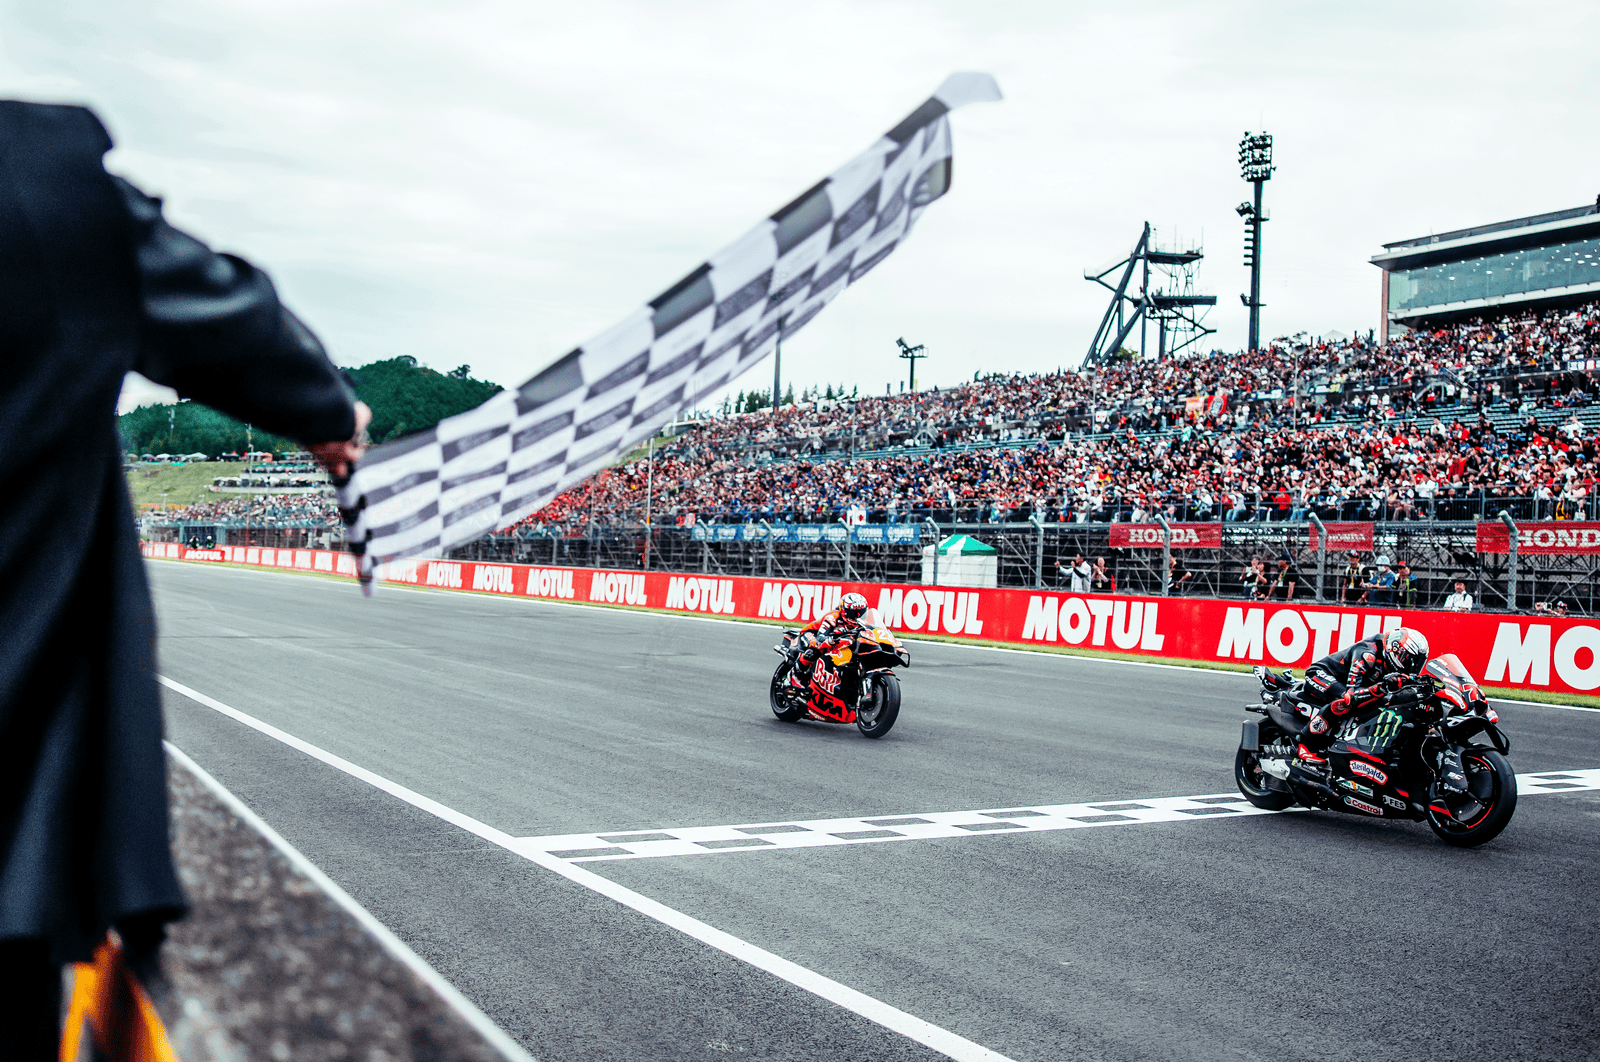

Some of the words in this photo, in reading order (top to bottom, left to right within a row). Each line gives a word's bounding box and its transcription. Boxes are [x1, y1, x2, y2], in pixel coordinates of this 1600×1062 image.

[1129, 528, 1200, 543] HONDA
[184, 550, 222, 561] MOTUL
[427, 562, 462, 588] MOTUL
[473, 565, 514, 593] MOTUL
[526, 569, 575, 599] MOTUL
[590, 572, 648, 606] MOTUL
[666, 577, 735, 614] MOTUL
[876, 588, 984, 635] MOTUL
[1022, 595, 1165, 651] MOTUL
[1216, 606, 1403, 664] MOT
[1352, 800, 1381, 815] Castrol
